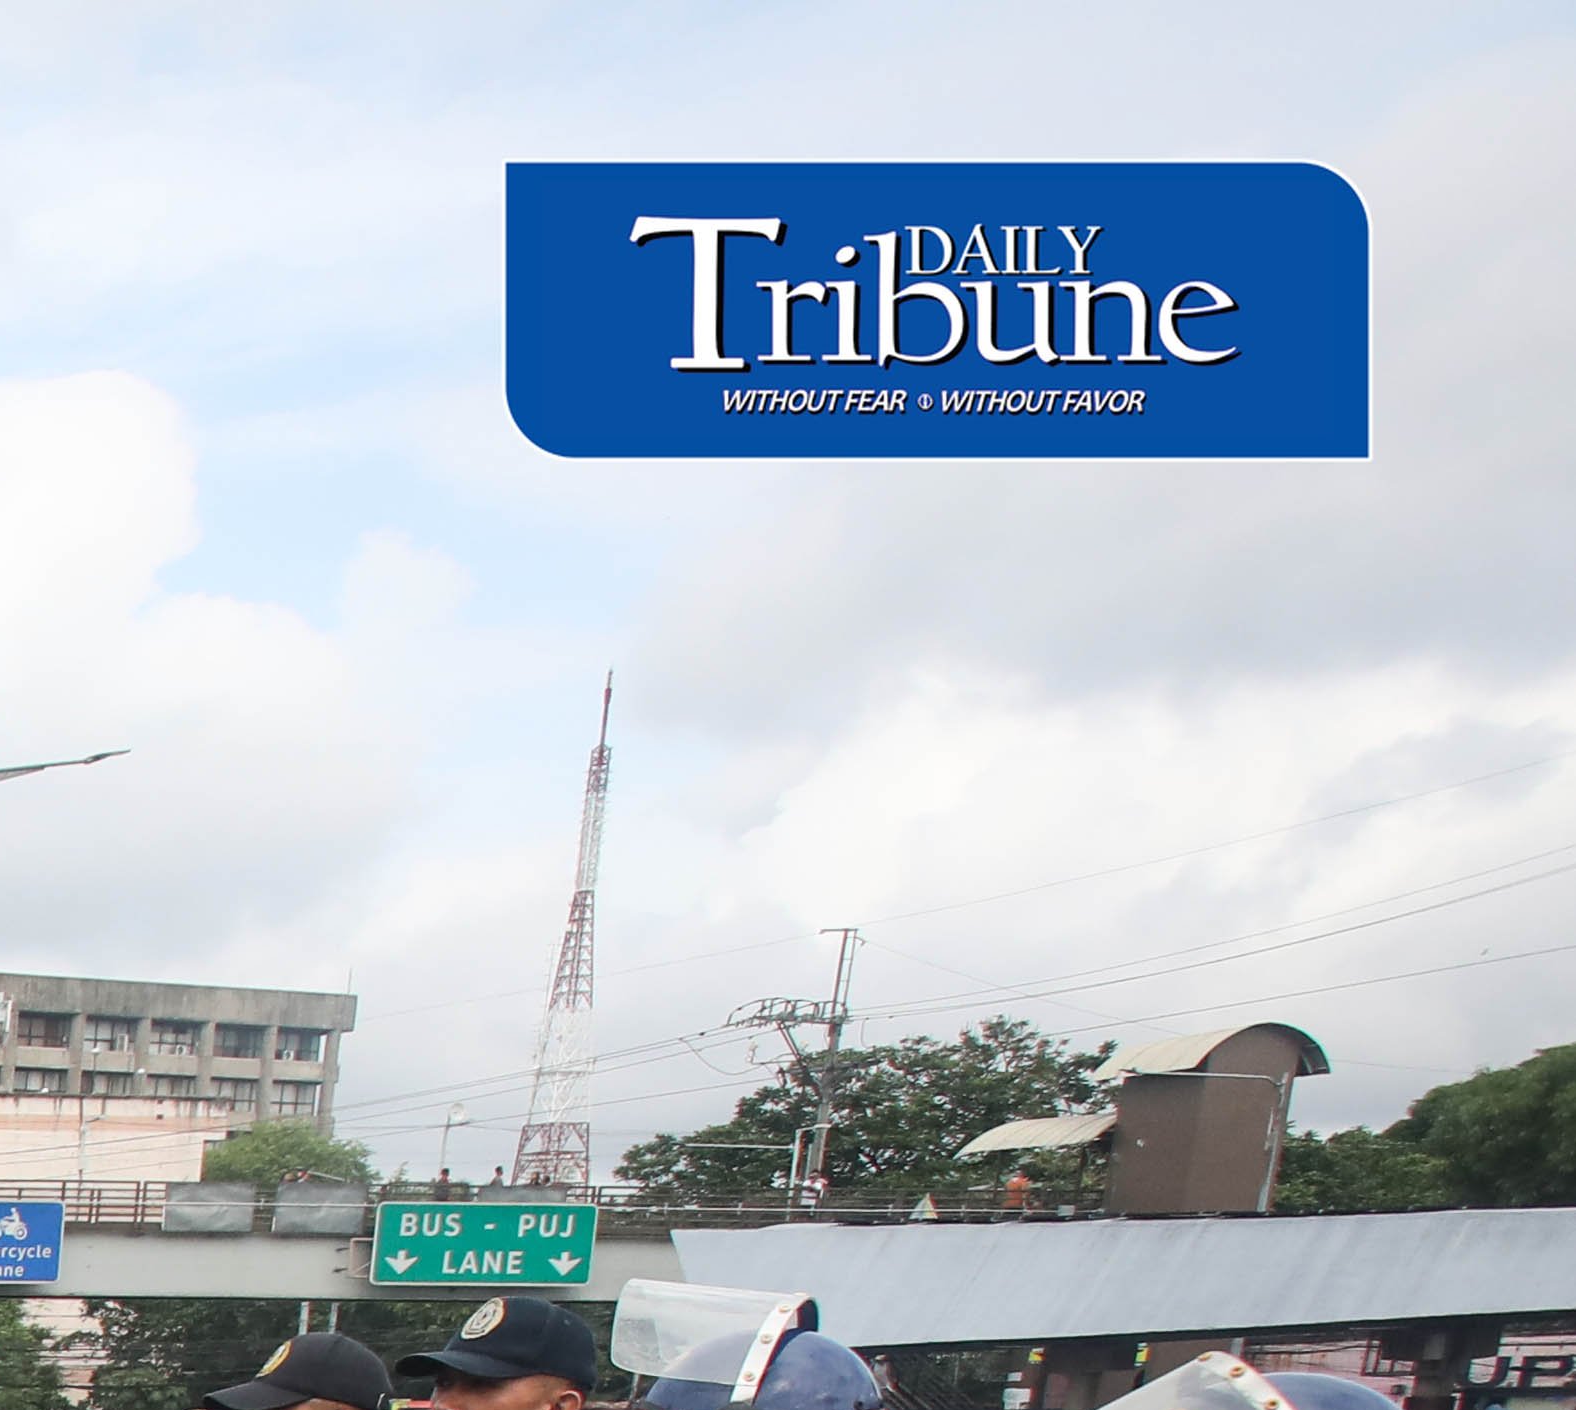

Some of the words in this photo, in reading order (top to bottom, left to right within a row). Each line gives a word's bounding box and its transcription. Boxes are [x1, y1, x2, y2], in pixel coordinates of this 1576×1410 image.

[399, 1212, 463, 1237] BUS
[517, 1213, 577, 1239] PUJ
[441, 1250, 524, 1275] LANE
